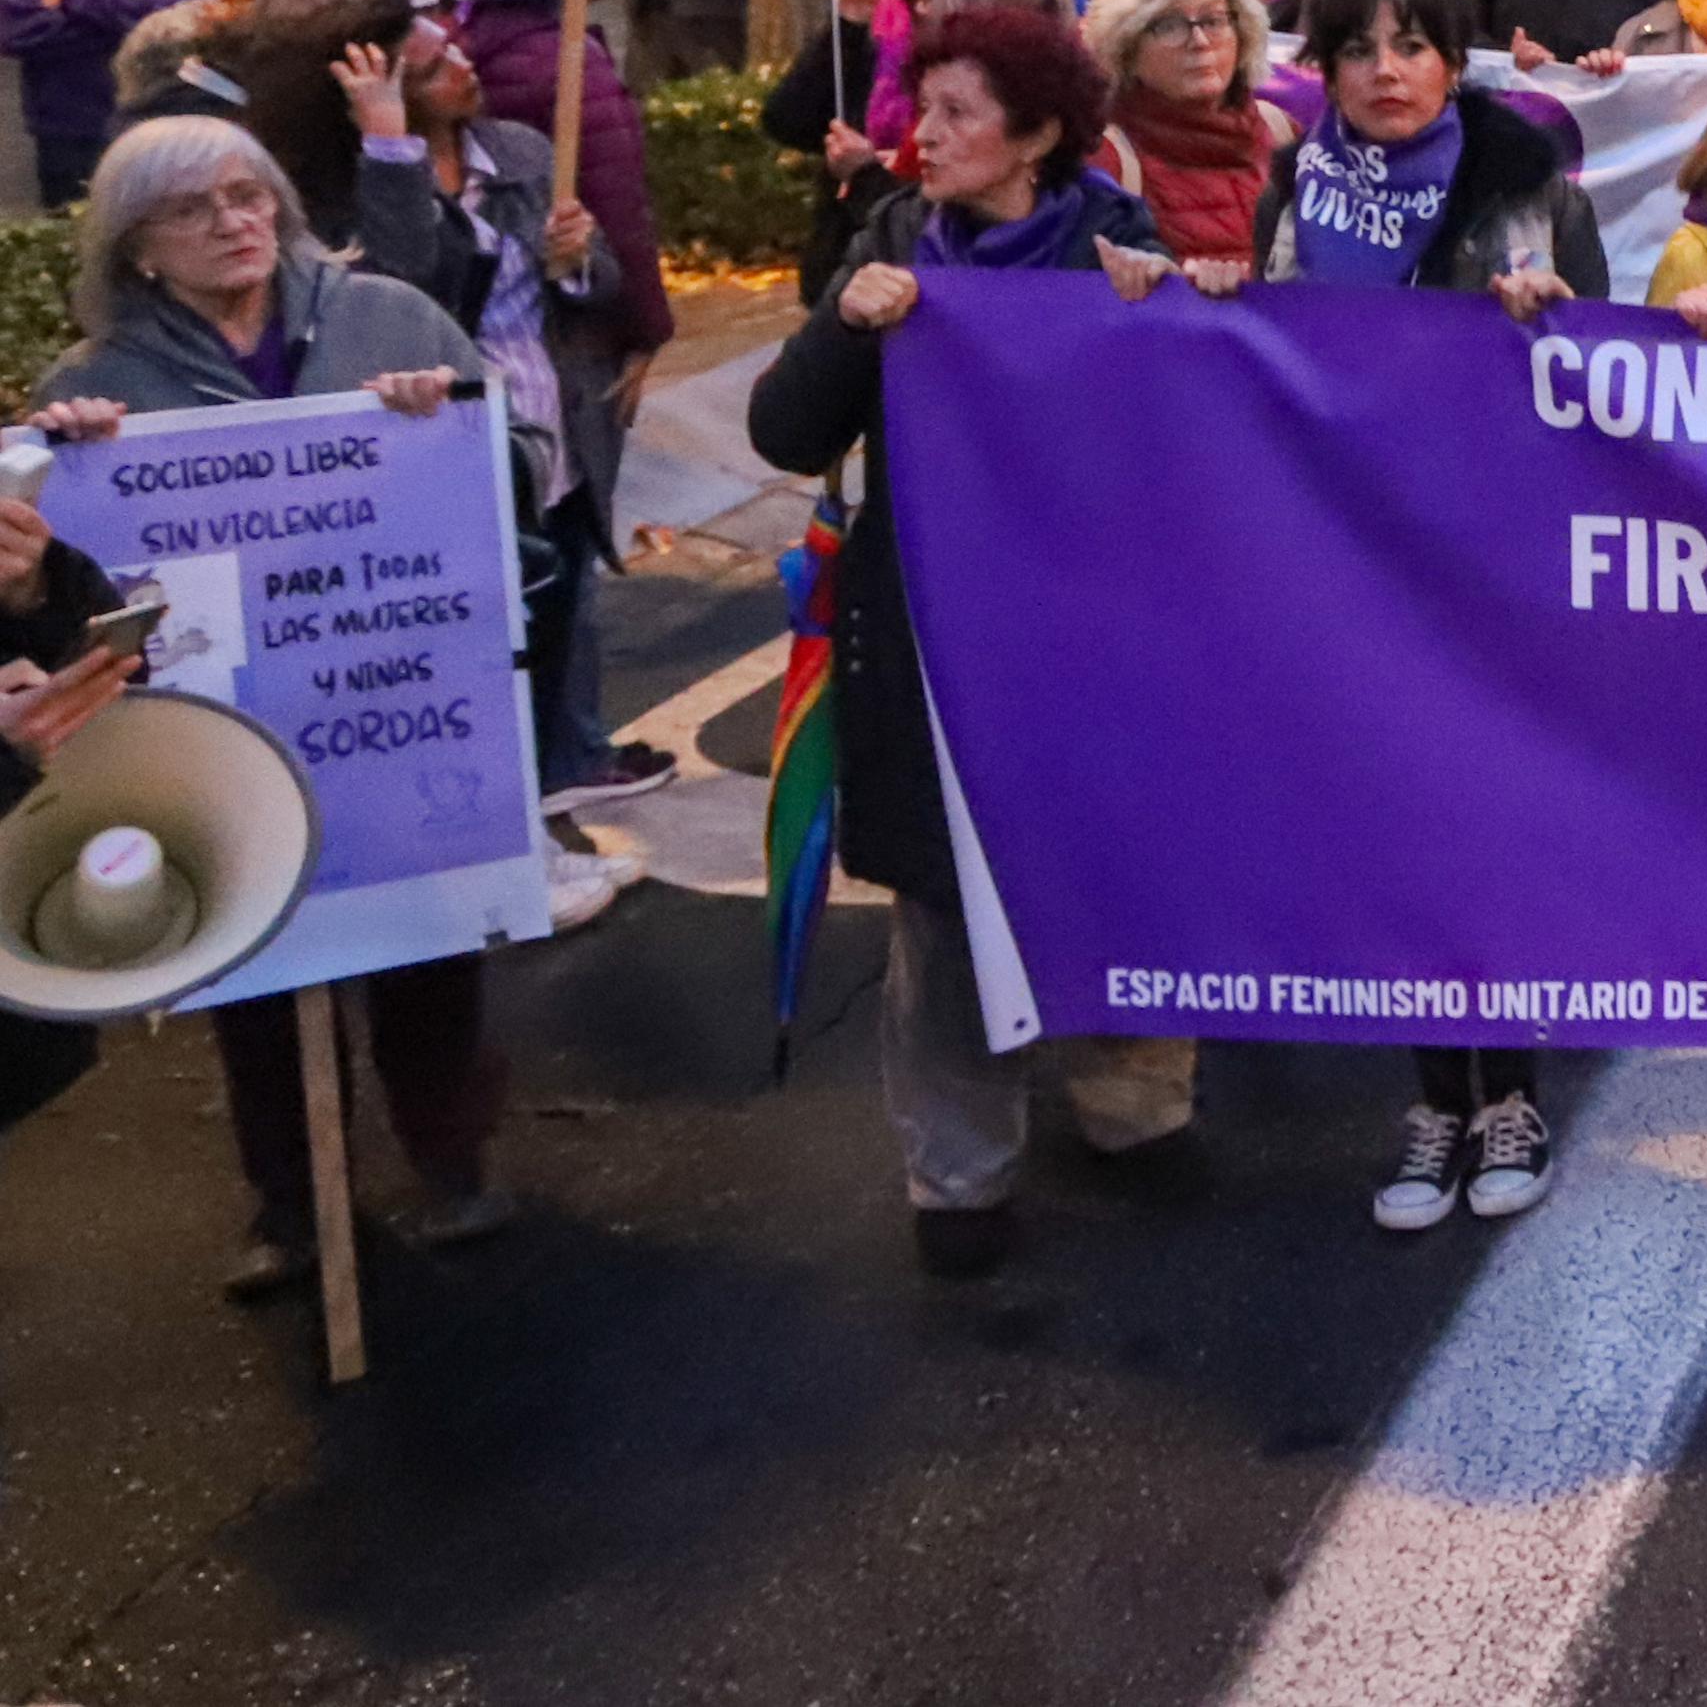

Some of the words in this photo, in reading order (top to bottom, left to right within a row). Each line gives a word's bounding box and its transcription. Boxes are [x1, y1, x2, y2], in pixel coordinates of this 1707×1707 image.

[112, 457, 275, 498] SOCIEDAD
[285, 436, 382, 477] LIBRE
[140, 522, 198, 555] SIN
[208, 497, 378, 545] VIOLENCIA
[264, 565, 346, 601] PARA
[262, 612, 321, 649] LAS
[332, 592, 471, 637] MUJERES
[312, 667, 336, 696] Y
[300, 698, 472, 763] SORDAS
[1107, 968, 1259, 1011] ESPACIO
[1270, 974, 1468, 1018] FEMINISMO
[1478, 980, 1653, 1021] UNITARIO
